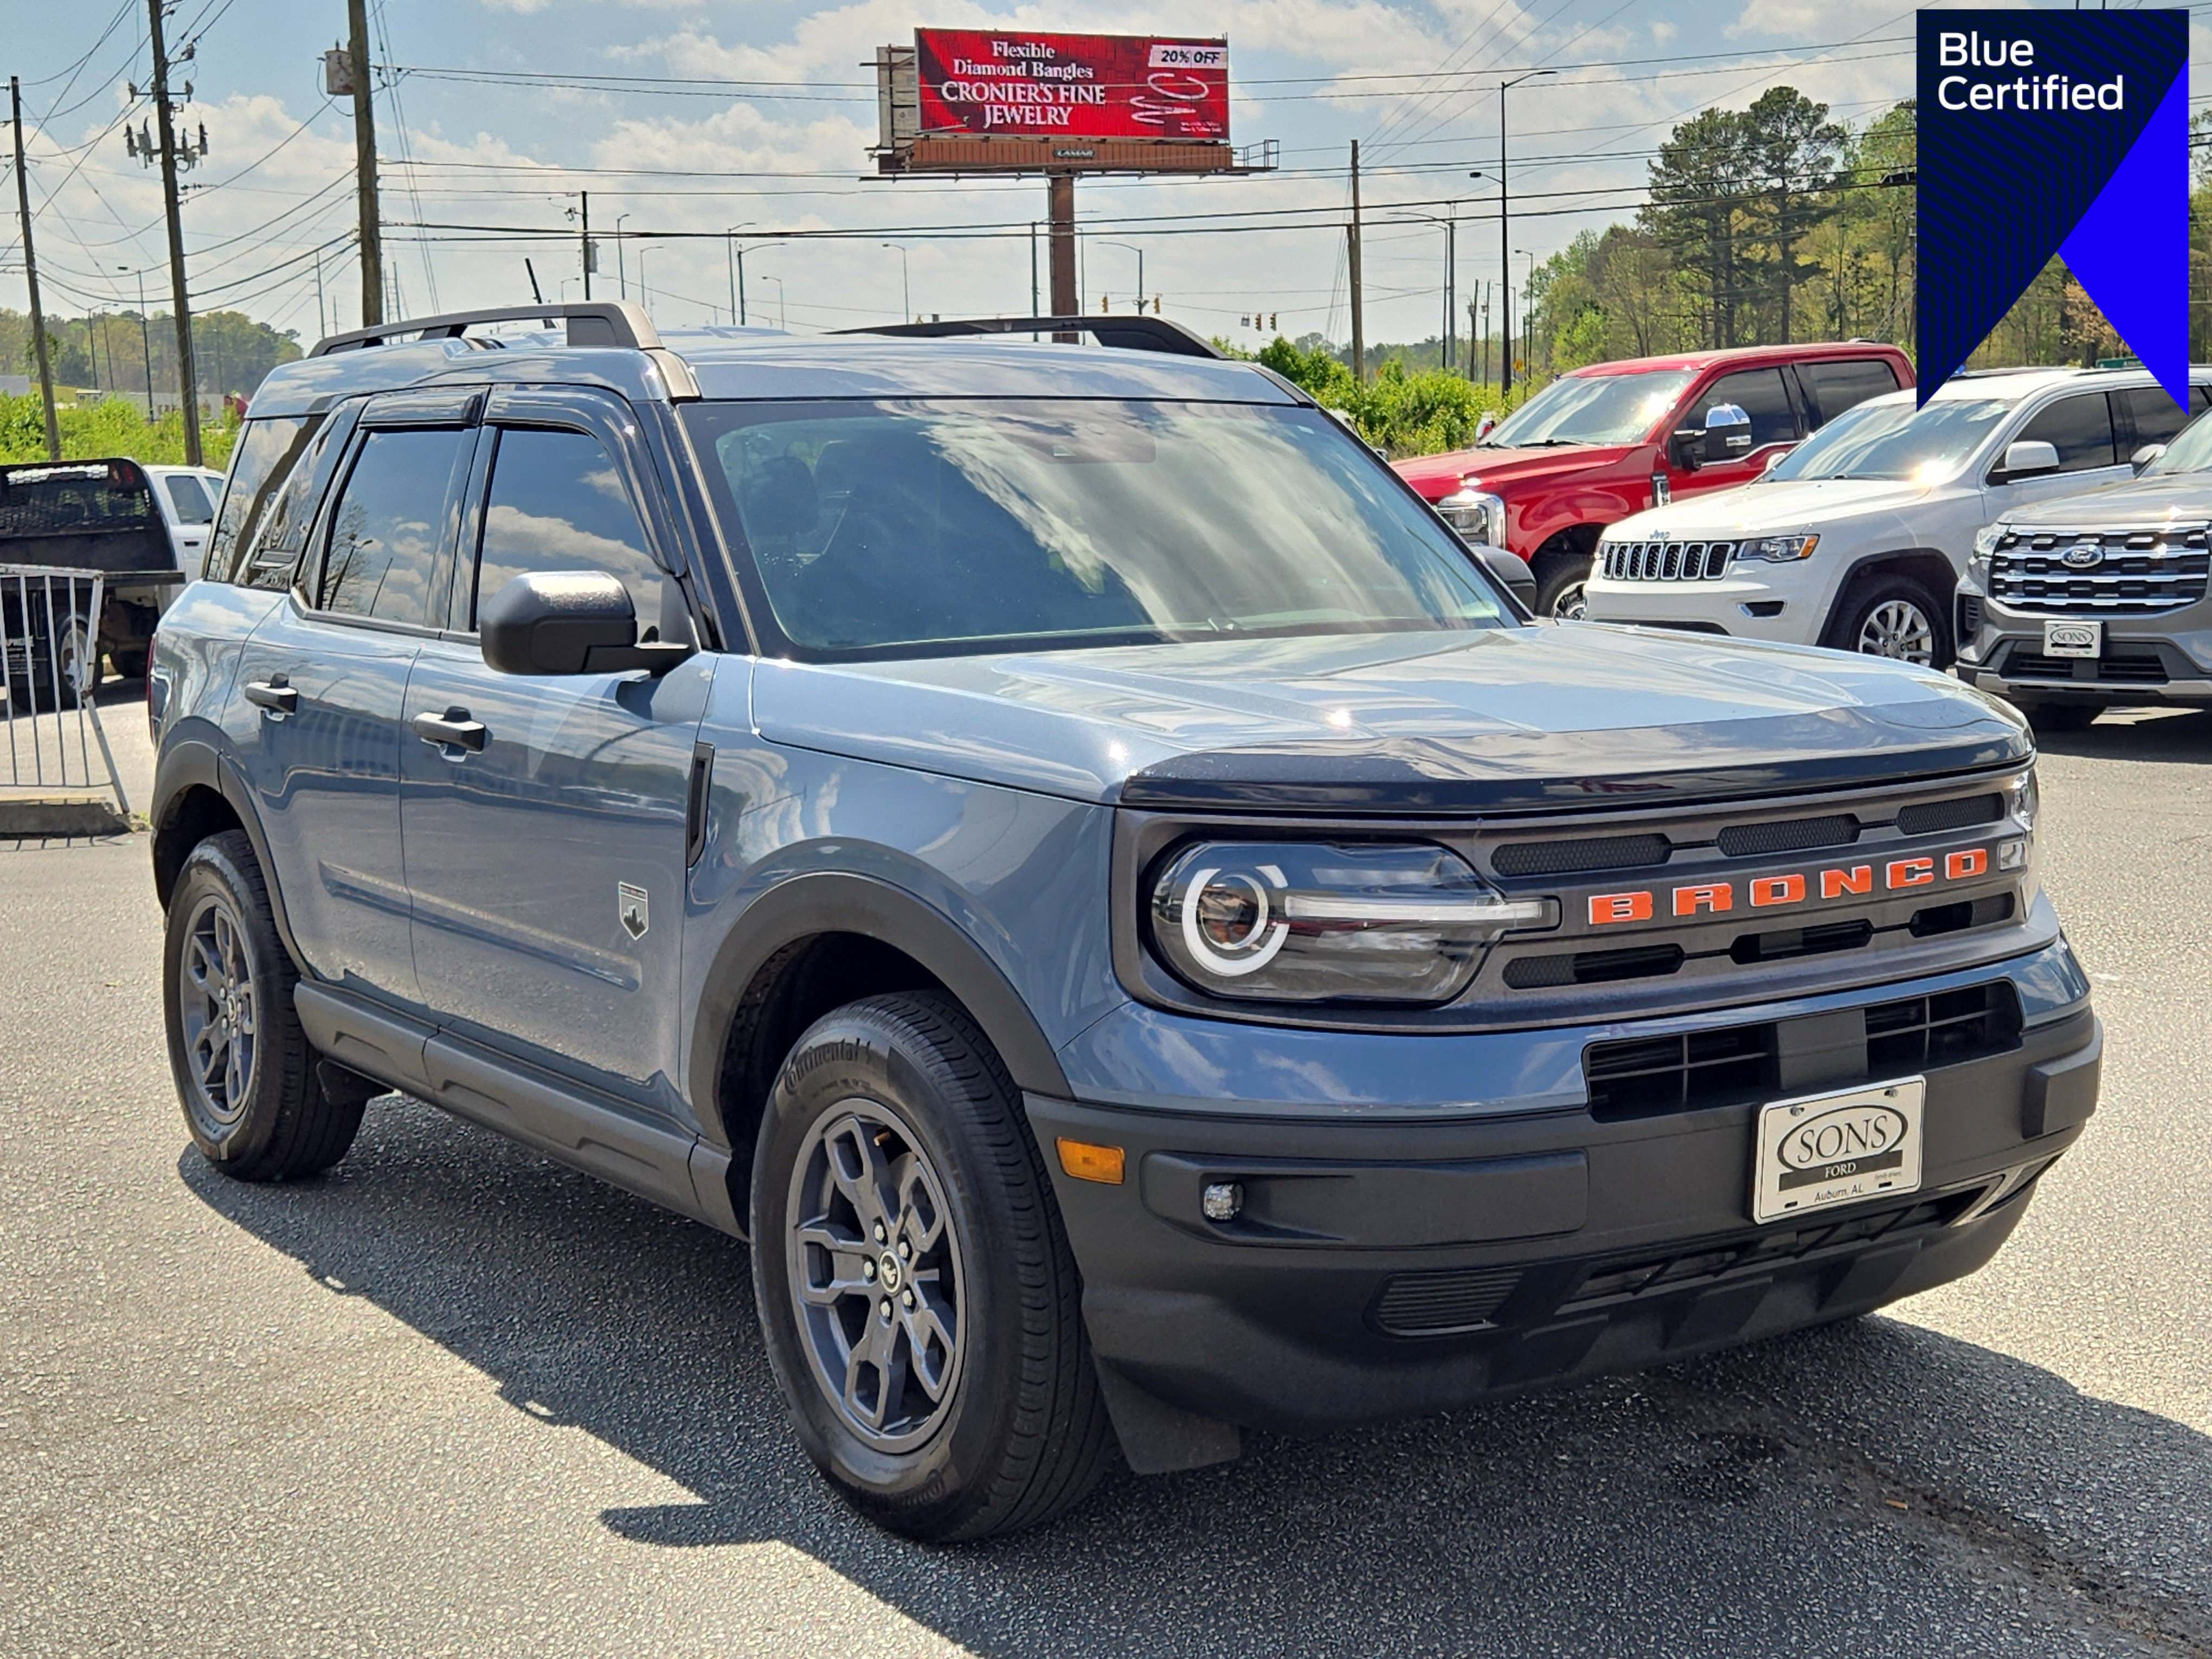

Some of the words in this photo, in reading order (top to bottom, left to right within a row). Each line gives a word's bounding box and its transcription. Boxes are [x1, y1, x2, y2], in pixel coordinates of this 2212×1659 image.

[991, 41, 1056, 59] Flexible
[1161, 50, 1190, 63] 20%
[1194, 52, 1220, 63] OFF
[953, 59, 1027, 77] Diamond
[1032, 61, 1094, 81] Bangles
[941, 81, 1053, 103] CRONIER'S
[1058, 85, 1107, 105] FINE
[983, 105, 1073, 129] JEWELRY
[2056, 632, 2087, 642] SONS
[1587, 848, 1988, 925] BRONCO
[785, 1038, 861, 1095] Continental
[1798, 1115, 1887, 1163] SONS
[1825, 1162, 1856, 1178] FORD
[1815, 1188, 1849, 1203] Auburn,
[1851, 1183, 1864, 1195] AL
